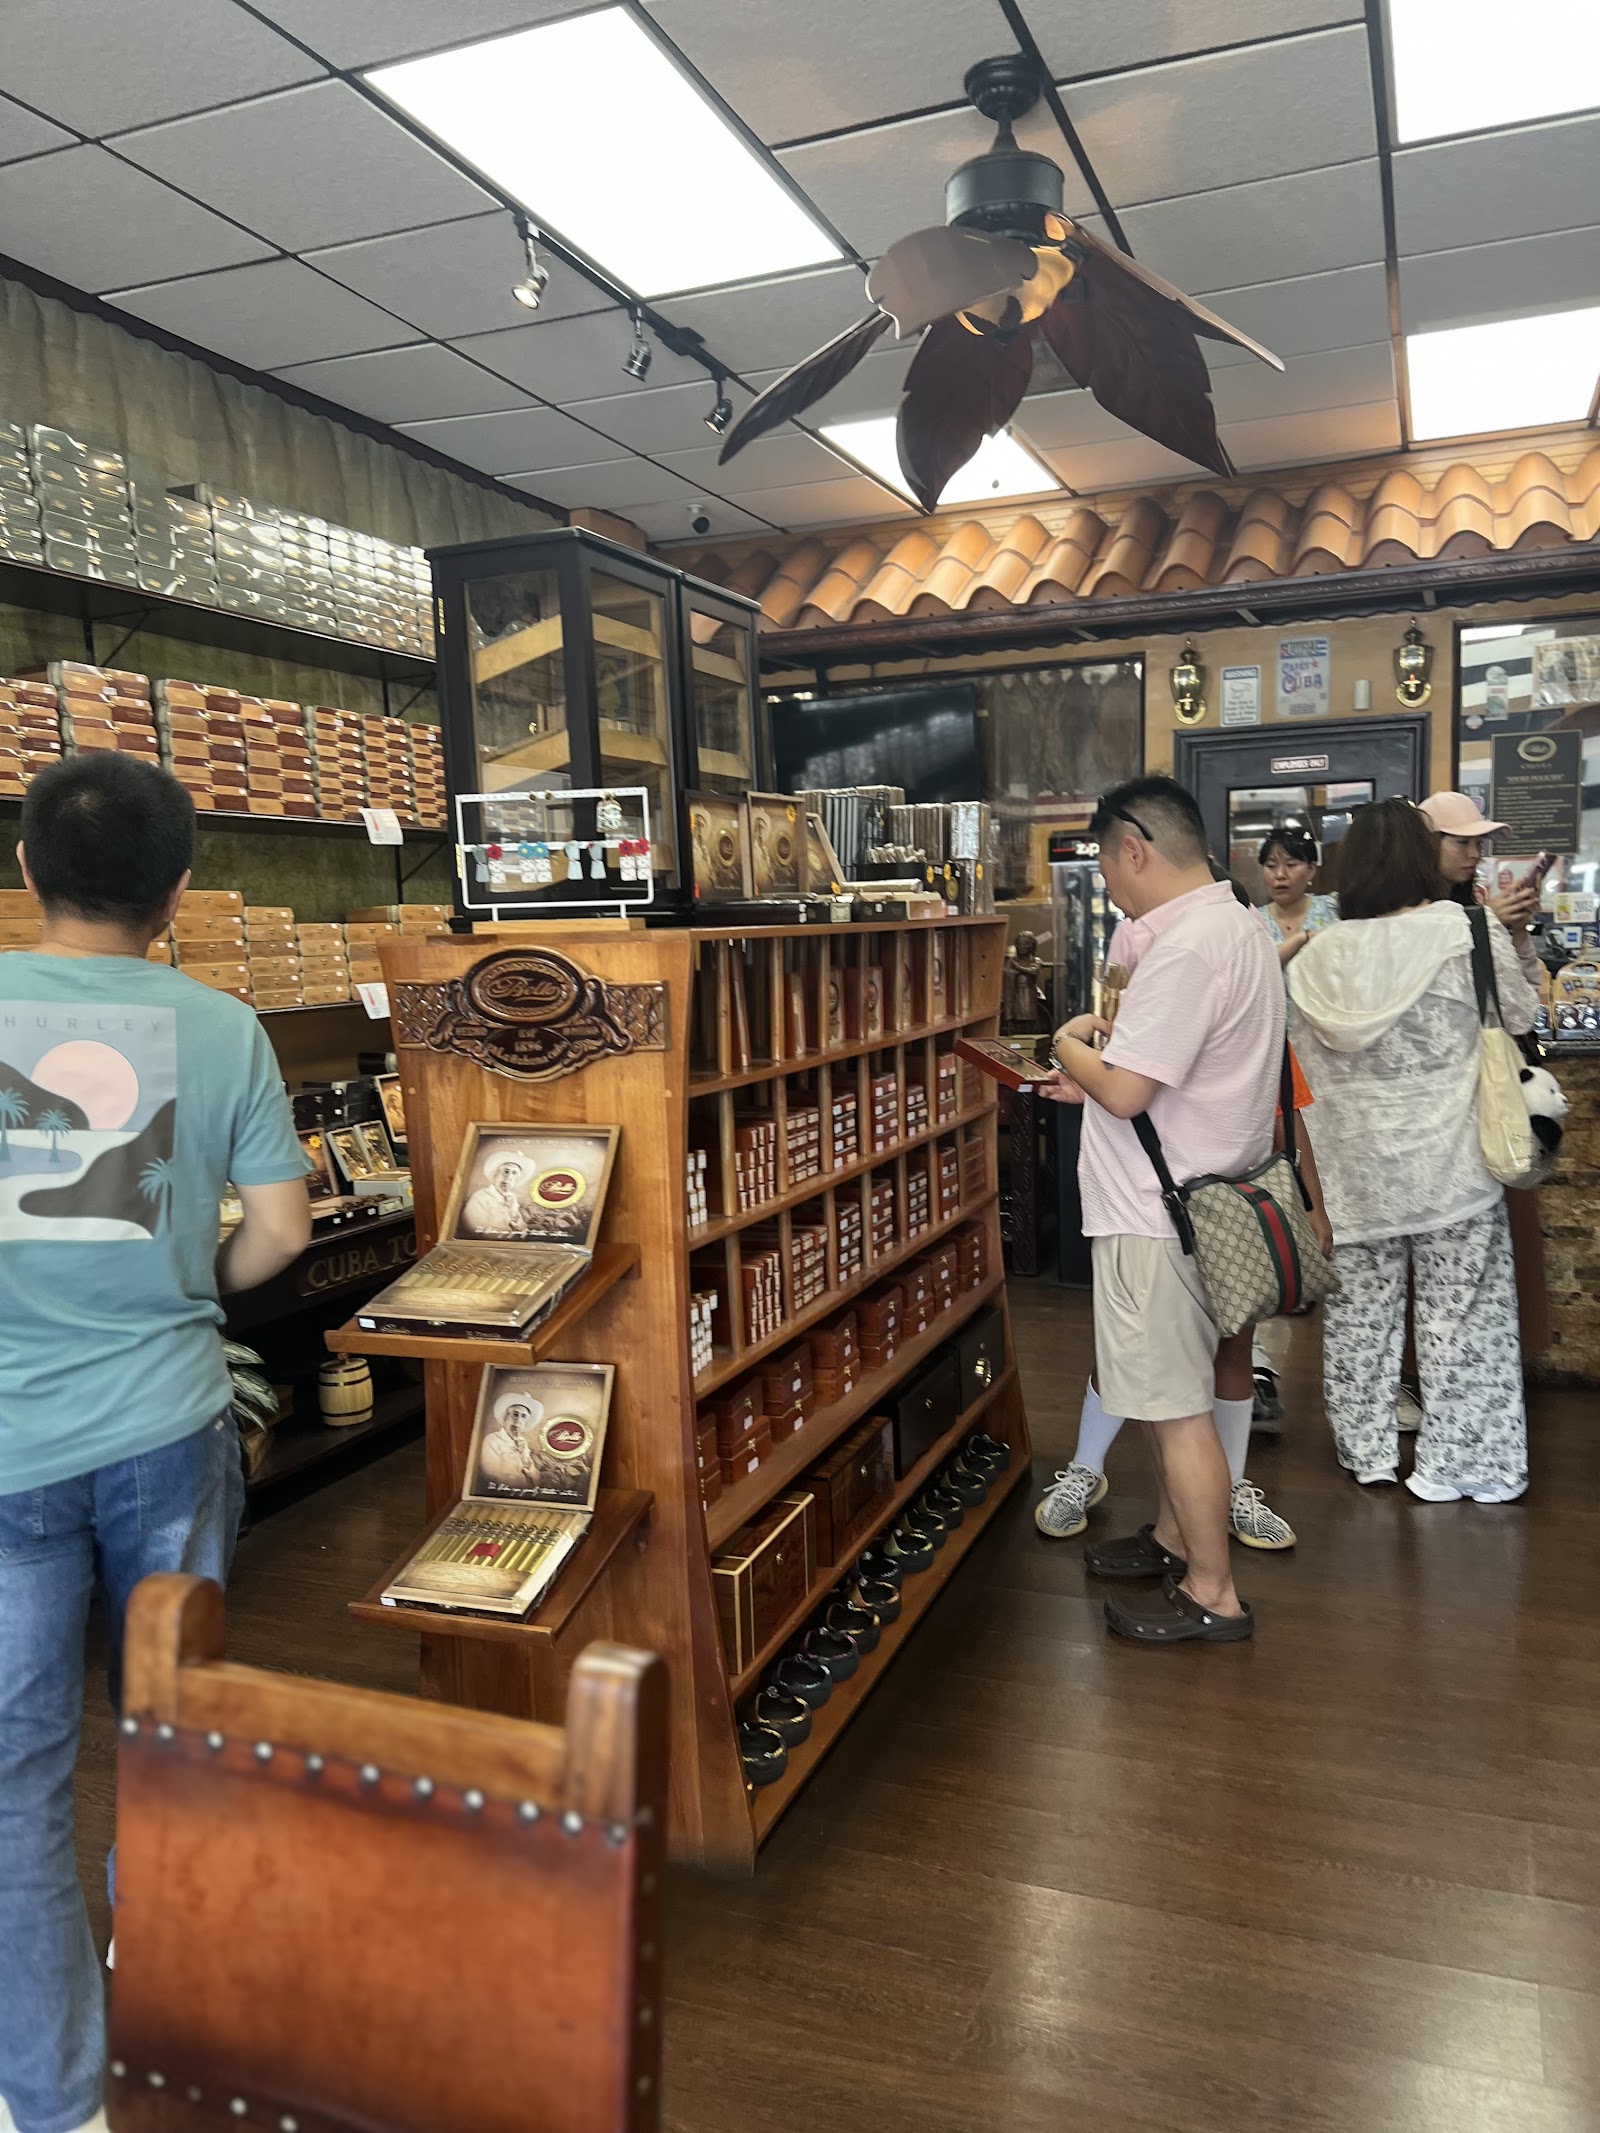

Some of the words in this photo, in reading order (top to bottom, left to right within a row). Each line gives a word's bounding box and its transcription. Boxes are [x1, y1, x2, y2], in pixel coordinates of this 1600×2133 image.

[1075, 842, 1100, 857] zip
[4, 1015, 160, 1032] HURLEY
[307, 1247, 381, 1288] CUBA
